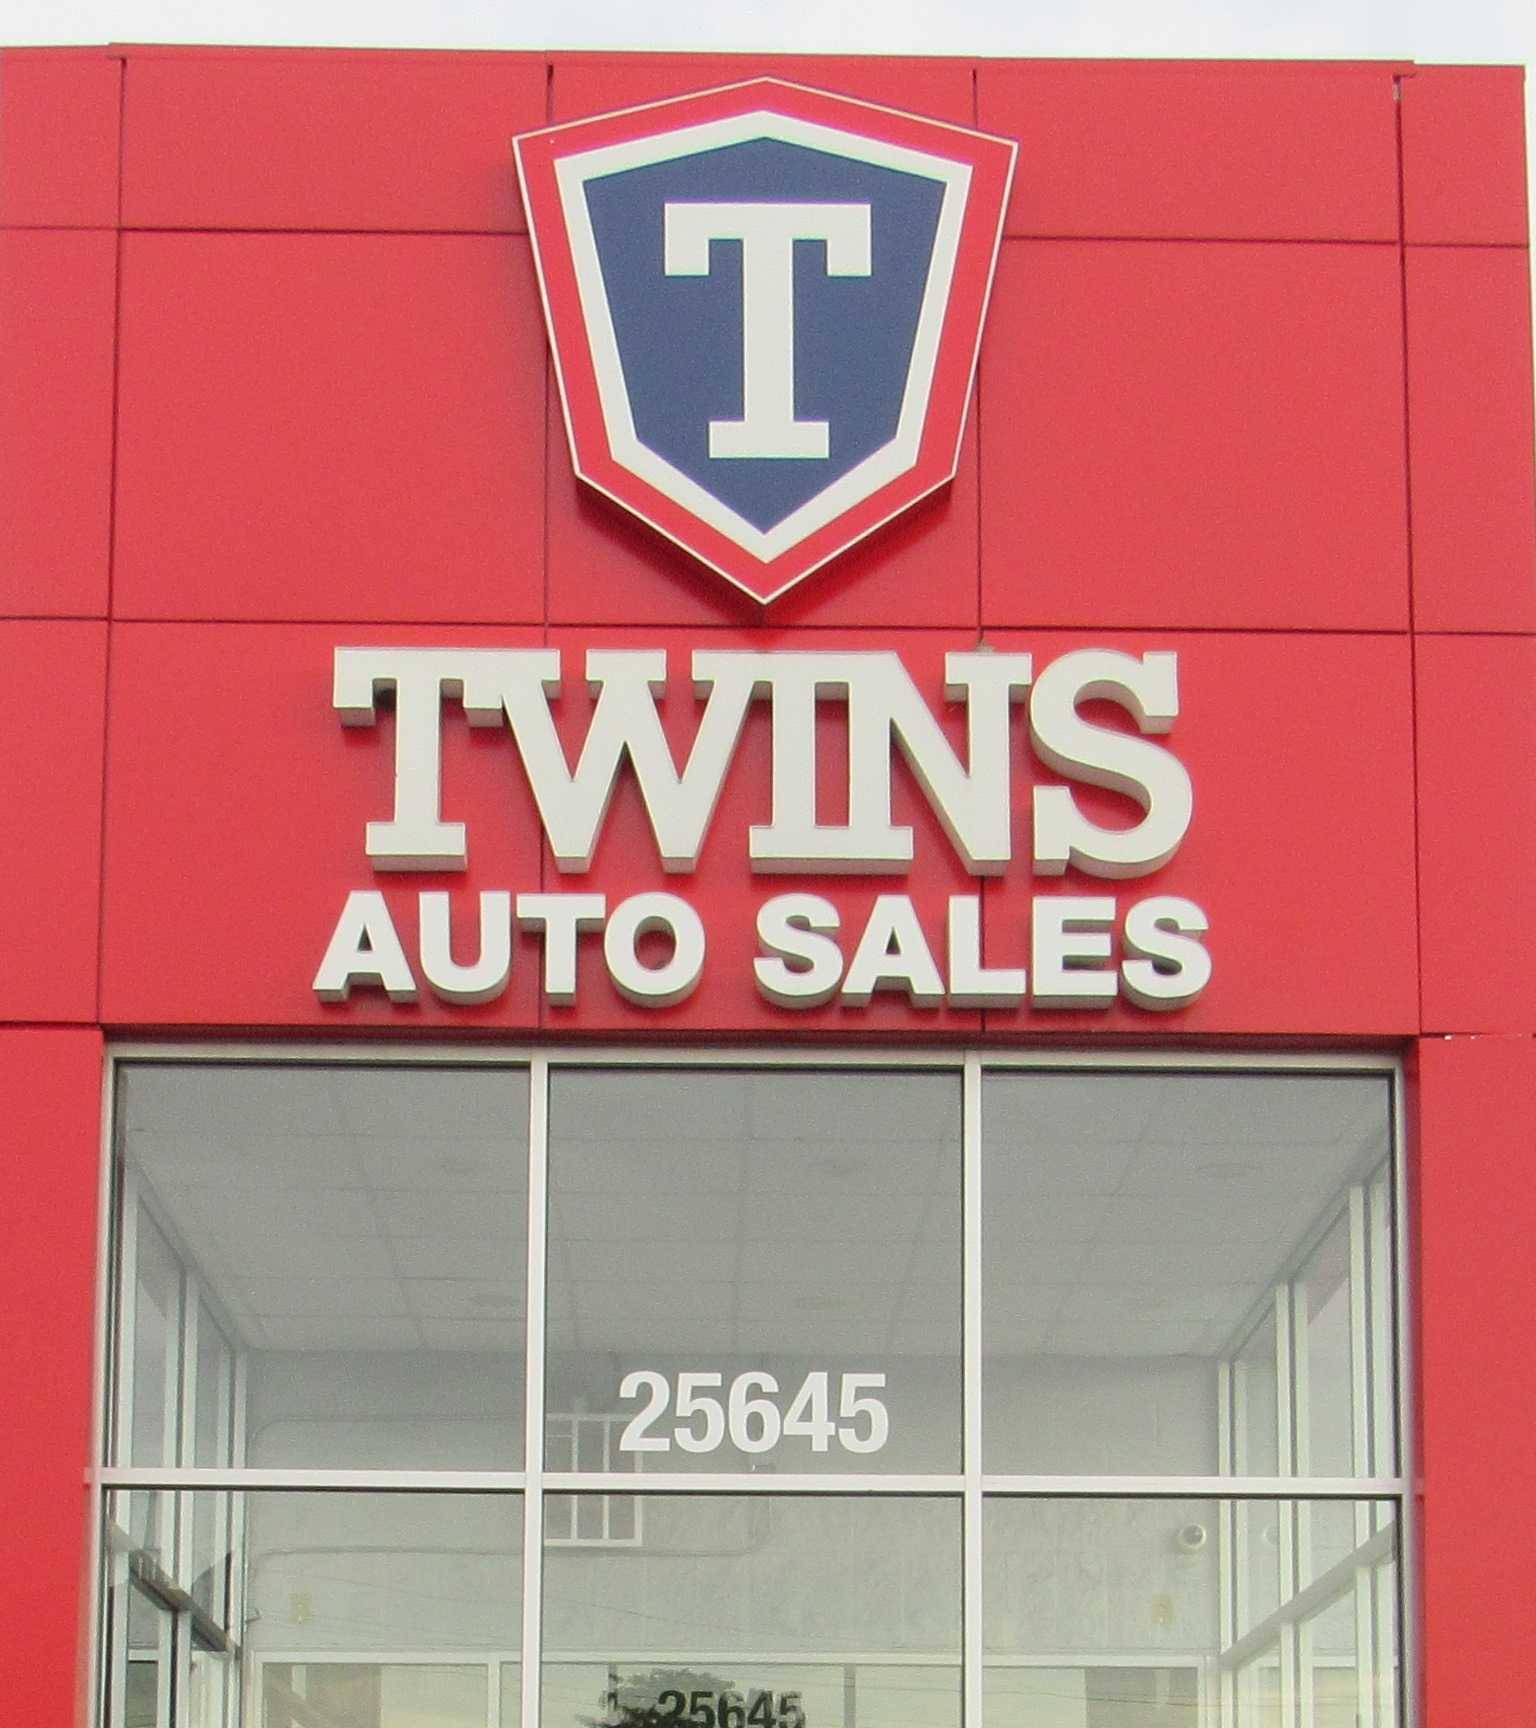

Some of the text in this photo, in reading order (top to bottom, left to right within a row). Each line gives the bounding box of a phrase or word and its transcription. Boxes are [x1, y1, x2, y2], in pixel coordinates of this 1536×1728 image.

[664, 203, 870, 458] T
[333, 647, 1193, 878] TWINS
[312, 890, 1212, 1010] AUTO SALES
[618, 1370, 889, 1454] 25645
